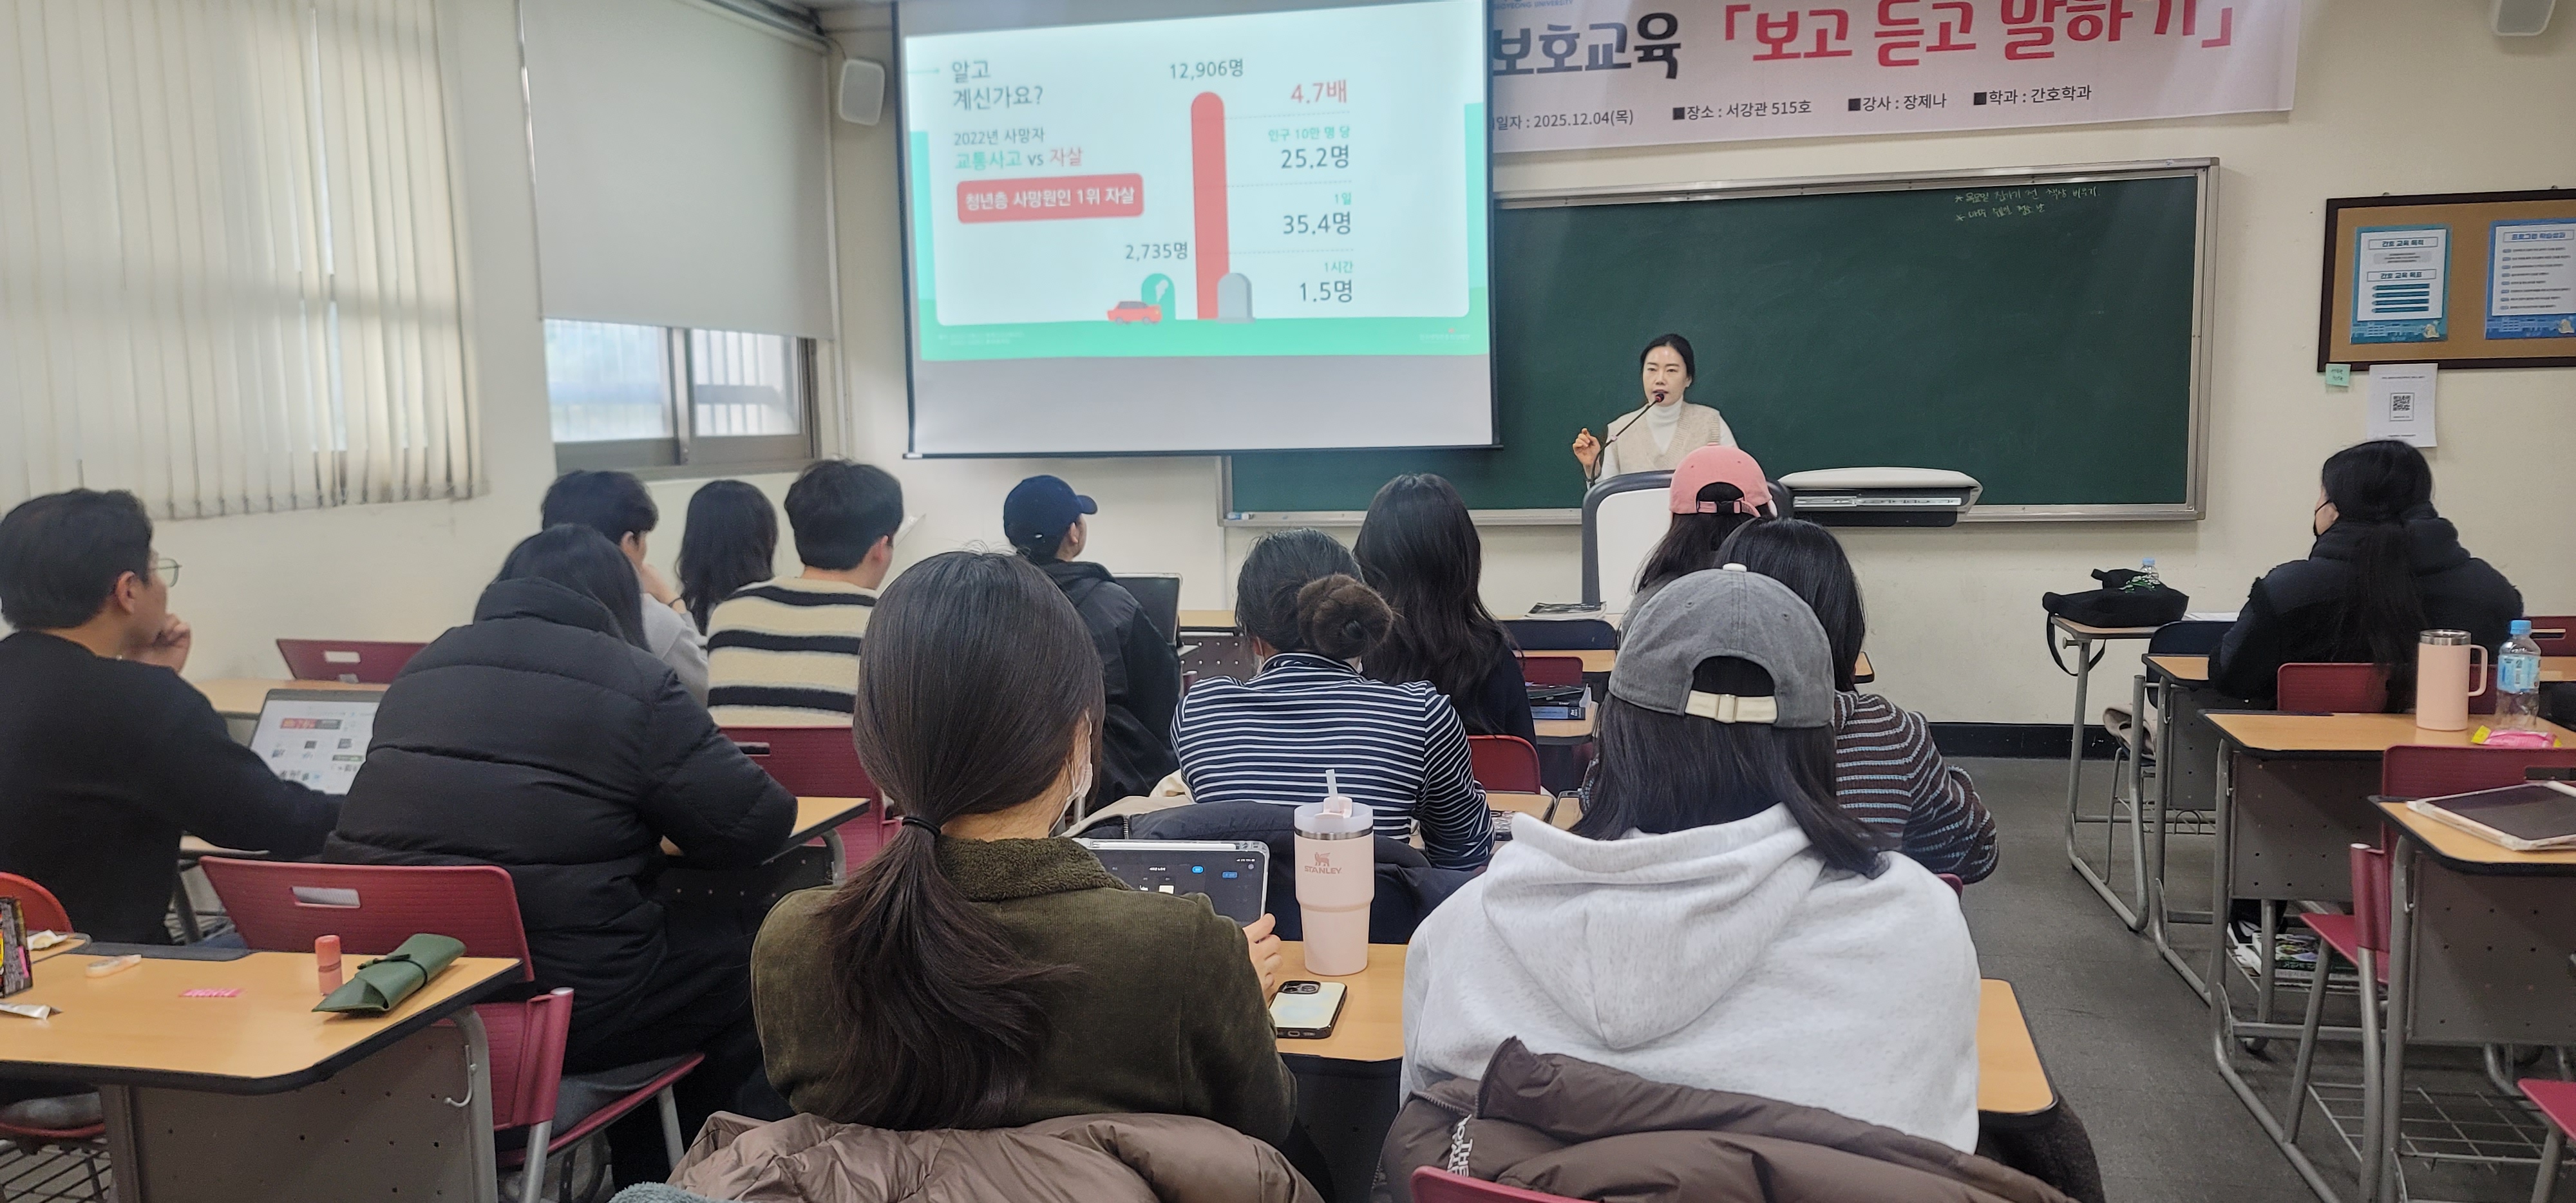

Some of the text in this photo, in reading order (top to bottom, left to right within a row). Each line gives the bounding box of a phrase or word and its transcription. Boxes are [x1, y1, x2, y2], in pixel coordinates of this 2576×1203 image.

[1493, 12, 1681, 79] 보호교육
[1875, 0, 1976, 66] 듣고
[952, 60, 990, 84] 알고
[1170, 58, 1244, 81] 12,906명
[954, 85, 1043, 111] 계신가요?
[1291, 79, 1347, 104] 4.7배
[1862, 96, 1891, 111] 강사
[1903, 93, 1947, 109] 장제나
[1989, 90, 2018, 105] 학과
[2030, 84, 2092, 103] 간호학과
[1496, 115, 1522, 131] 일자
[1533, 109, 1634, 128] 2025.12.04(목)
[1687, 105, 1714, 120] 장소
[1726, 102, 1768, 118] 서강관
[1772, 100, 1812, 115] 515호
[954, 127, 1045, 146] 2022년 사망자
[1268, 126, 1350, 142] 인구 10만 명 당
[955, 146, 1083, 171] 교통사고 vs 자살
[1281, 144, 1349, 169] 25.2명
[966, 187, 1135, 211] 청년층 사망원인 1위 자살
[1334, 192, 1352, 205] 1일
[1283, 211, 1351, 235] 35.4명
[1126, 242, 1188, 262] 2,735명
[1324, 261, 1353, 274] 1시간
[1300, 279, 1352, 303] 1.5명
[1304, 865, 1342, 875] STANLEY
